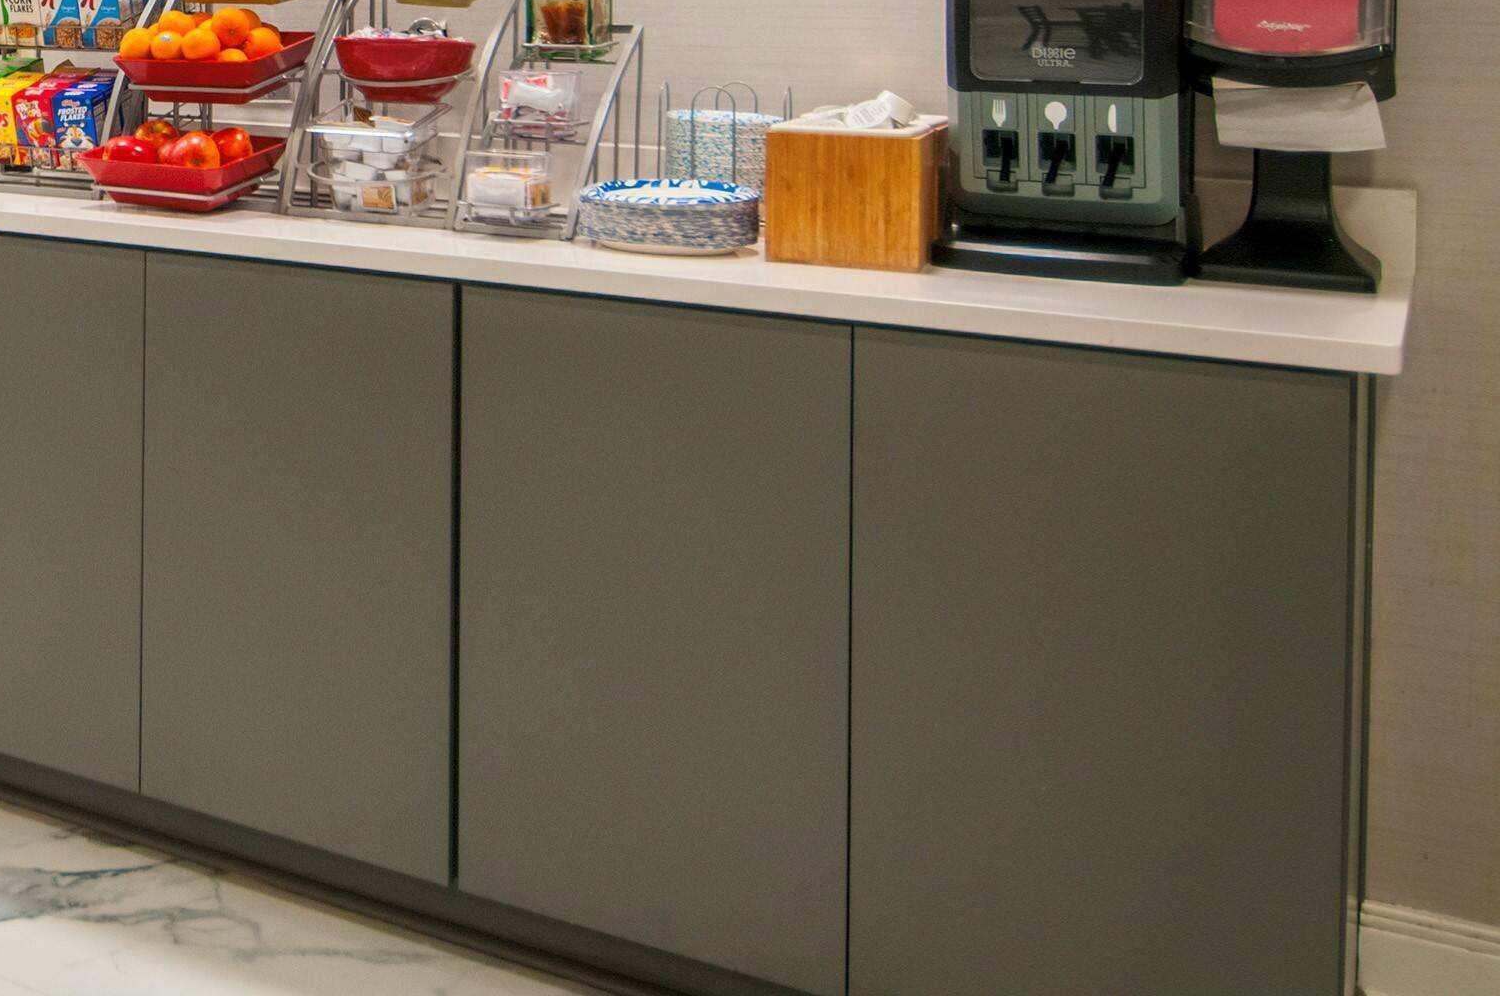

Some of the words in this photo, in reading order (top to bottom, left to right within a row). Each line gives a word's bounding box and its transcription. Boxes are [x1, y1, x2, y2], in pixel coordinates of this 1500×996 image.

[10, 4, 34, 13] FLAKES
[58, 106, 88, 116] FROSTED
[60, 114, 86, 122] FLAKES
